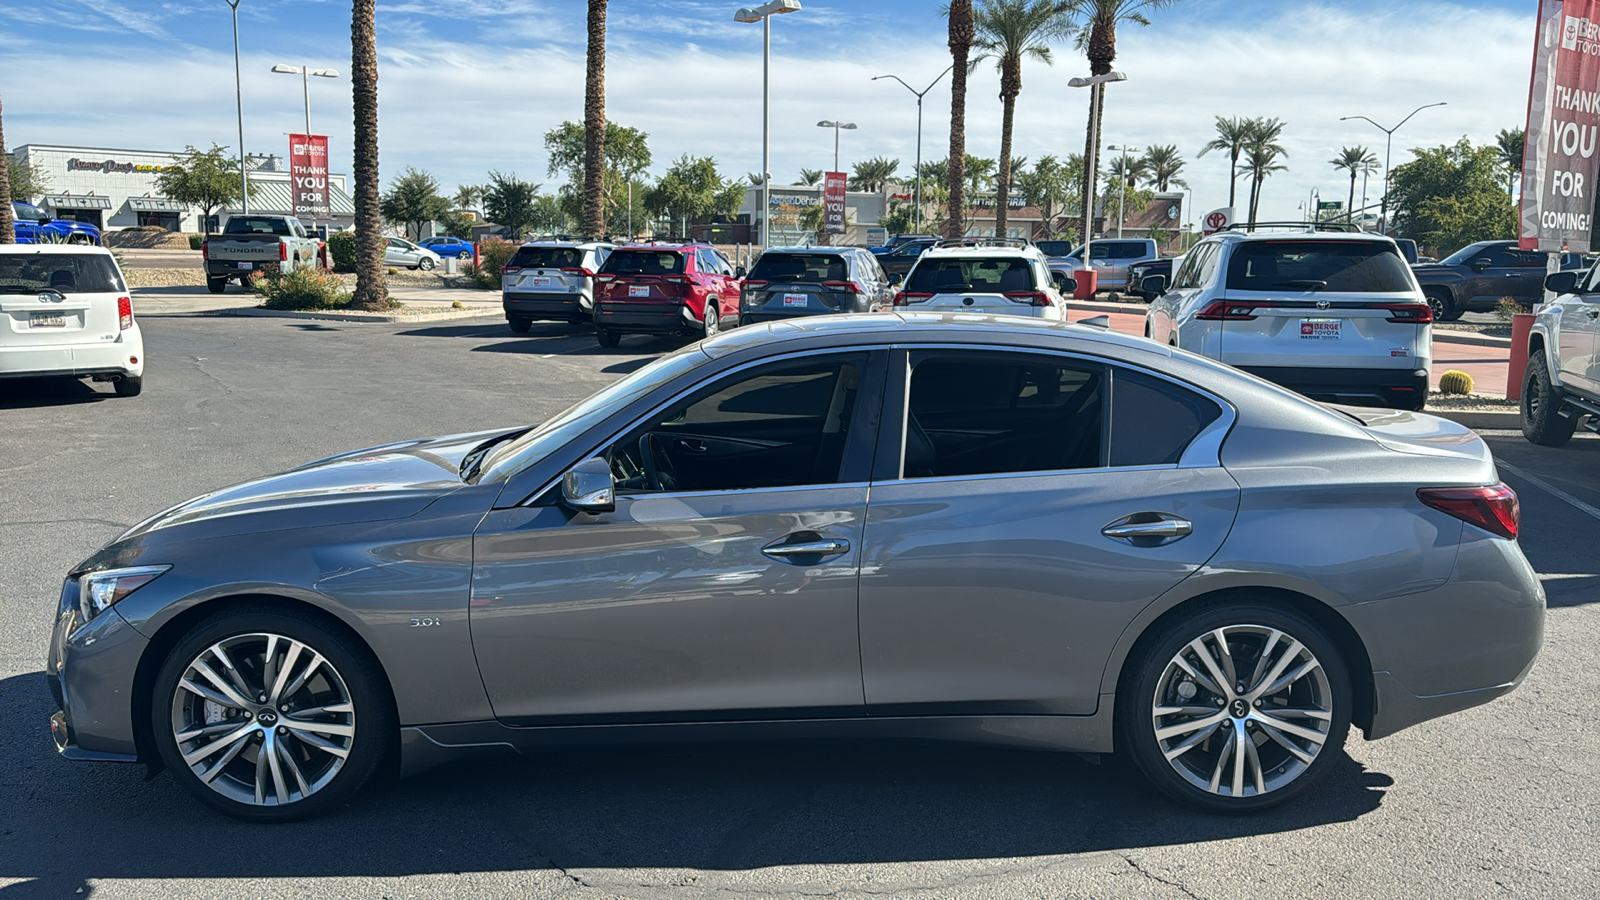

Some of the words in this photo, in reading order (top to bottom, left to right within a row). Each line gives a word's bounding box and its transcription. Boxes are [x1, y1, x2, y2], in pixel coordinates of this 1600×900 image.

[1555, 84, 1600, 114] THANK
[1553, 119, 1597, 158] YOU
[294, 165, 326, 175] THANK
[295, 177, 326, 189] YOU
[1552, 169, 1584, 198] FOR
[301, 192, 323, 202] FOR
[295, 205, 330, 213] COMING!
[827, 203, 844, 212] YOU
[829, 214, 842, 222] FOR
[1541, 210, 1590, 231] COMING!
[410, 617, 441, 627] 3.0t
